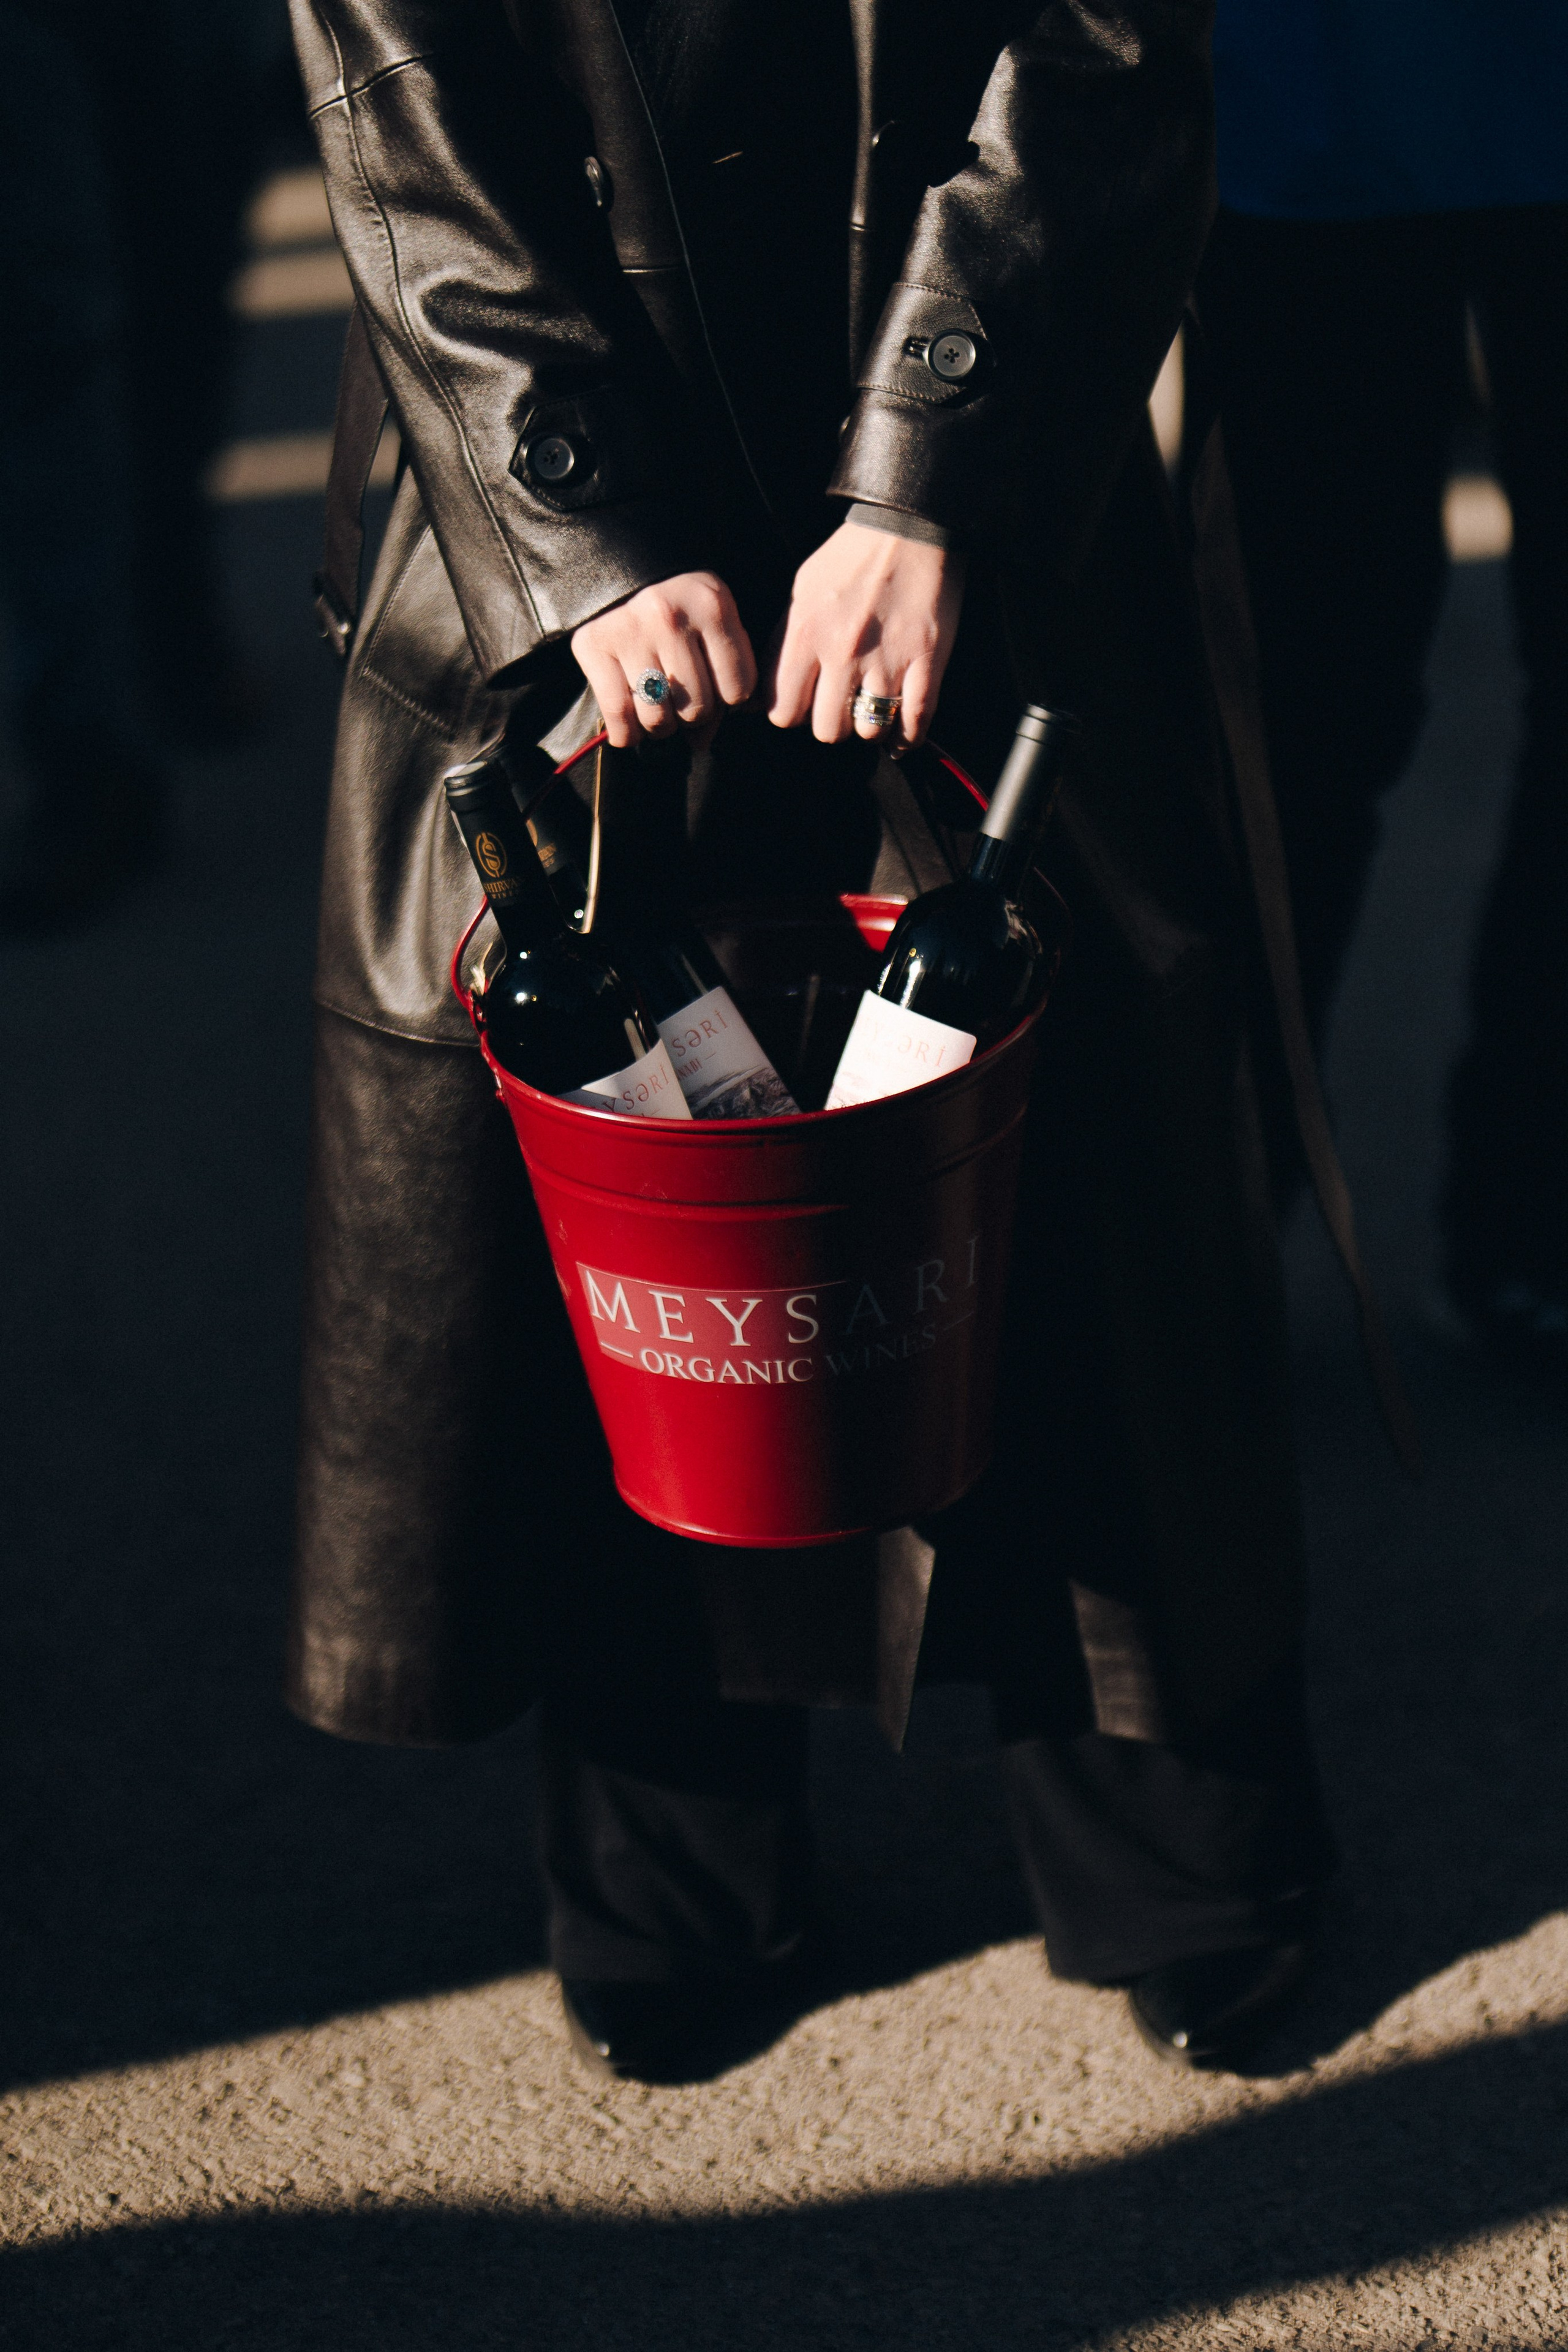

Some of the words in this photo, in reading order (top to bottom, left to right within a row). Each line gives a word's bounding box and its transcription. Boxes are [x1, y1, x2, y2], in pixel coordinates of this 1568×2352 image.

[483, 877, 518, 893] SHIRVA
[673, 1010, 729, 1057] SƏRİ
[602, 1062, 669, 1113] YSƏRİ
[585, 1234, 979, 1348] MEYSARI
[639, 1348, 814, 1385] ORGANIC
[826, 1323, 937, 1376] WINES
